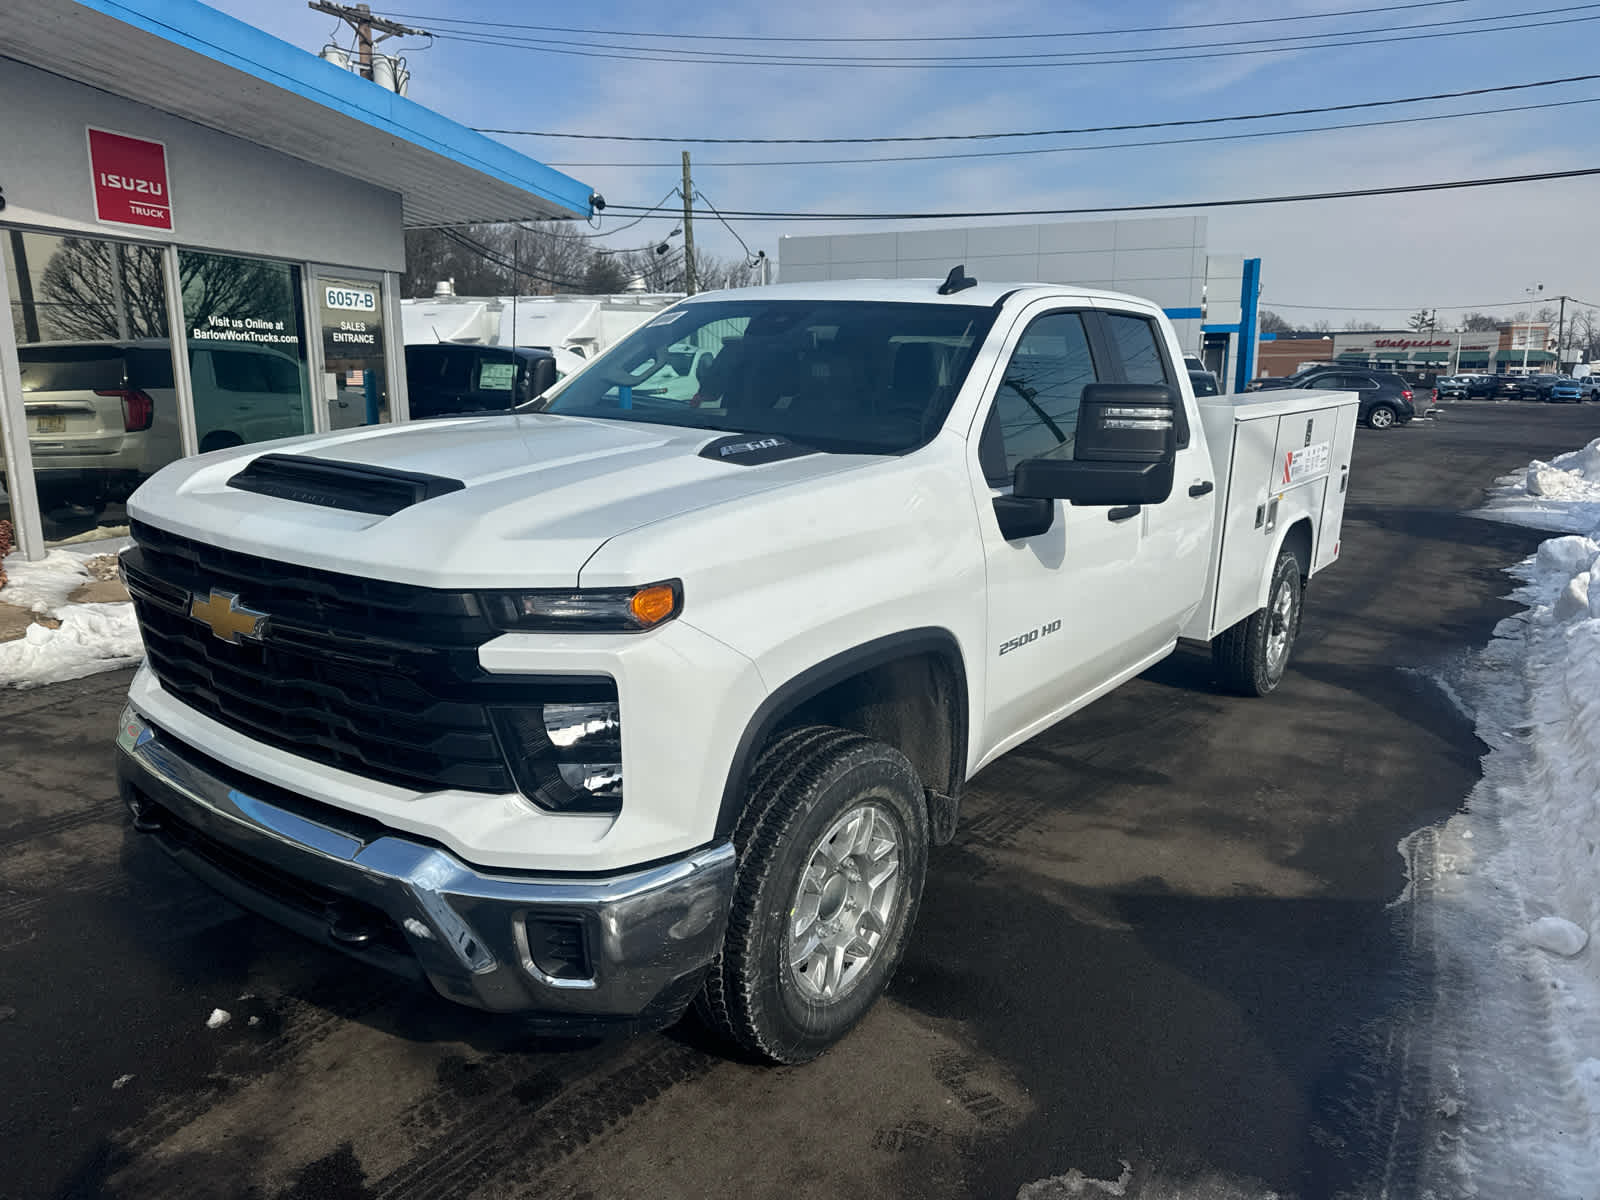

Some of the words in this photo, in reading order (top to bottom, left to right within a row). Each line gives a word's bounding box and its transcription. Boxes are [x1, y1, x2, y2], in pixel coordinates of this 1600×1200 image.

[101, 173, 162, 195] ISUZU
[129, 206, 165, 219] TRUCK
[328, 290, 374, 308] 6057-B
[208, 315, 230, 327] Visit
[231, 319, 243, 328] us
[245, 318, 274, 330] Online
[275, 320, 284, 331] at
[340, 321, 366, 332] SALES
[193, 328, 299, 344] BarlowWorkTrucks.com
[332, 332, 375, 344] ENTRANCE
[999, 629, 1039, 656] 2500
[1041, 619, 1062, 637] HD
